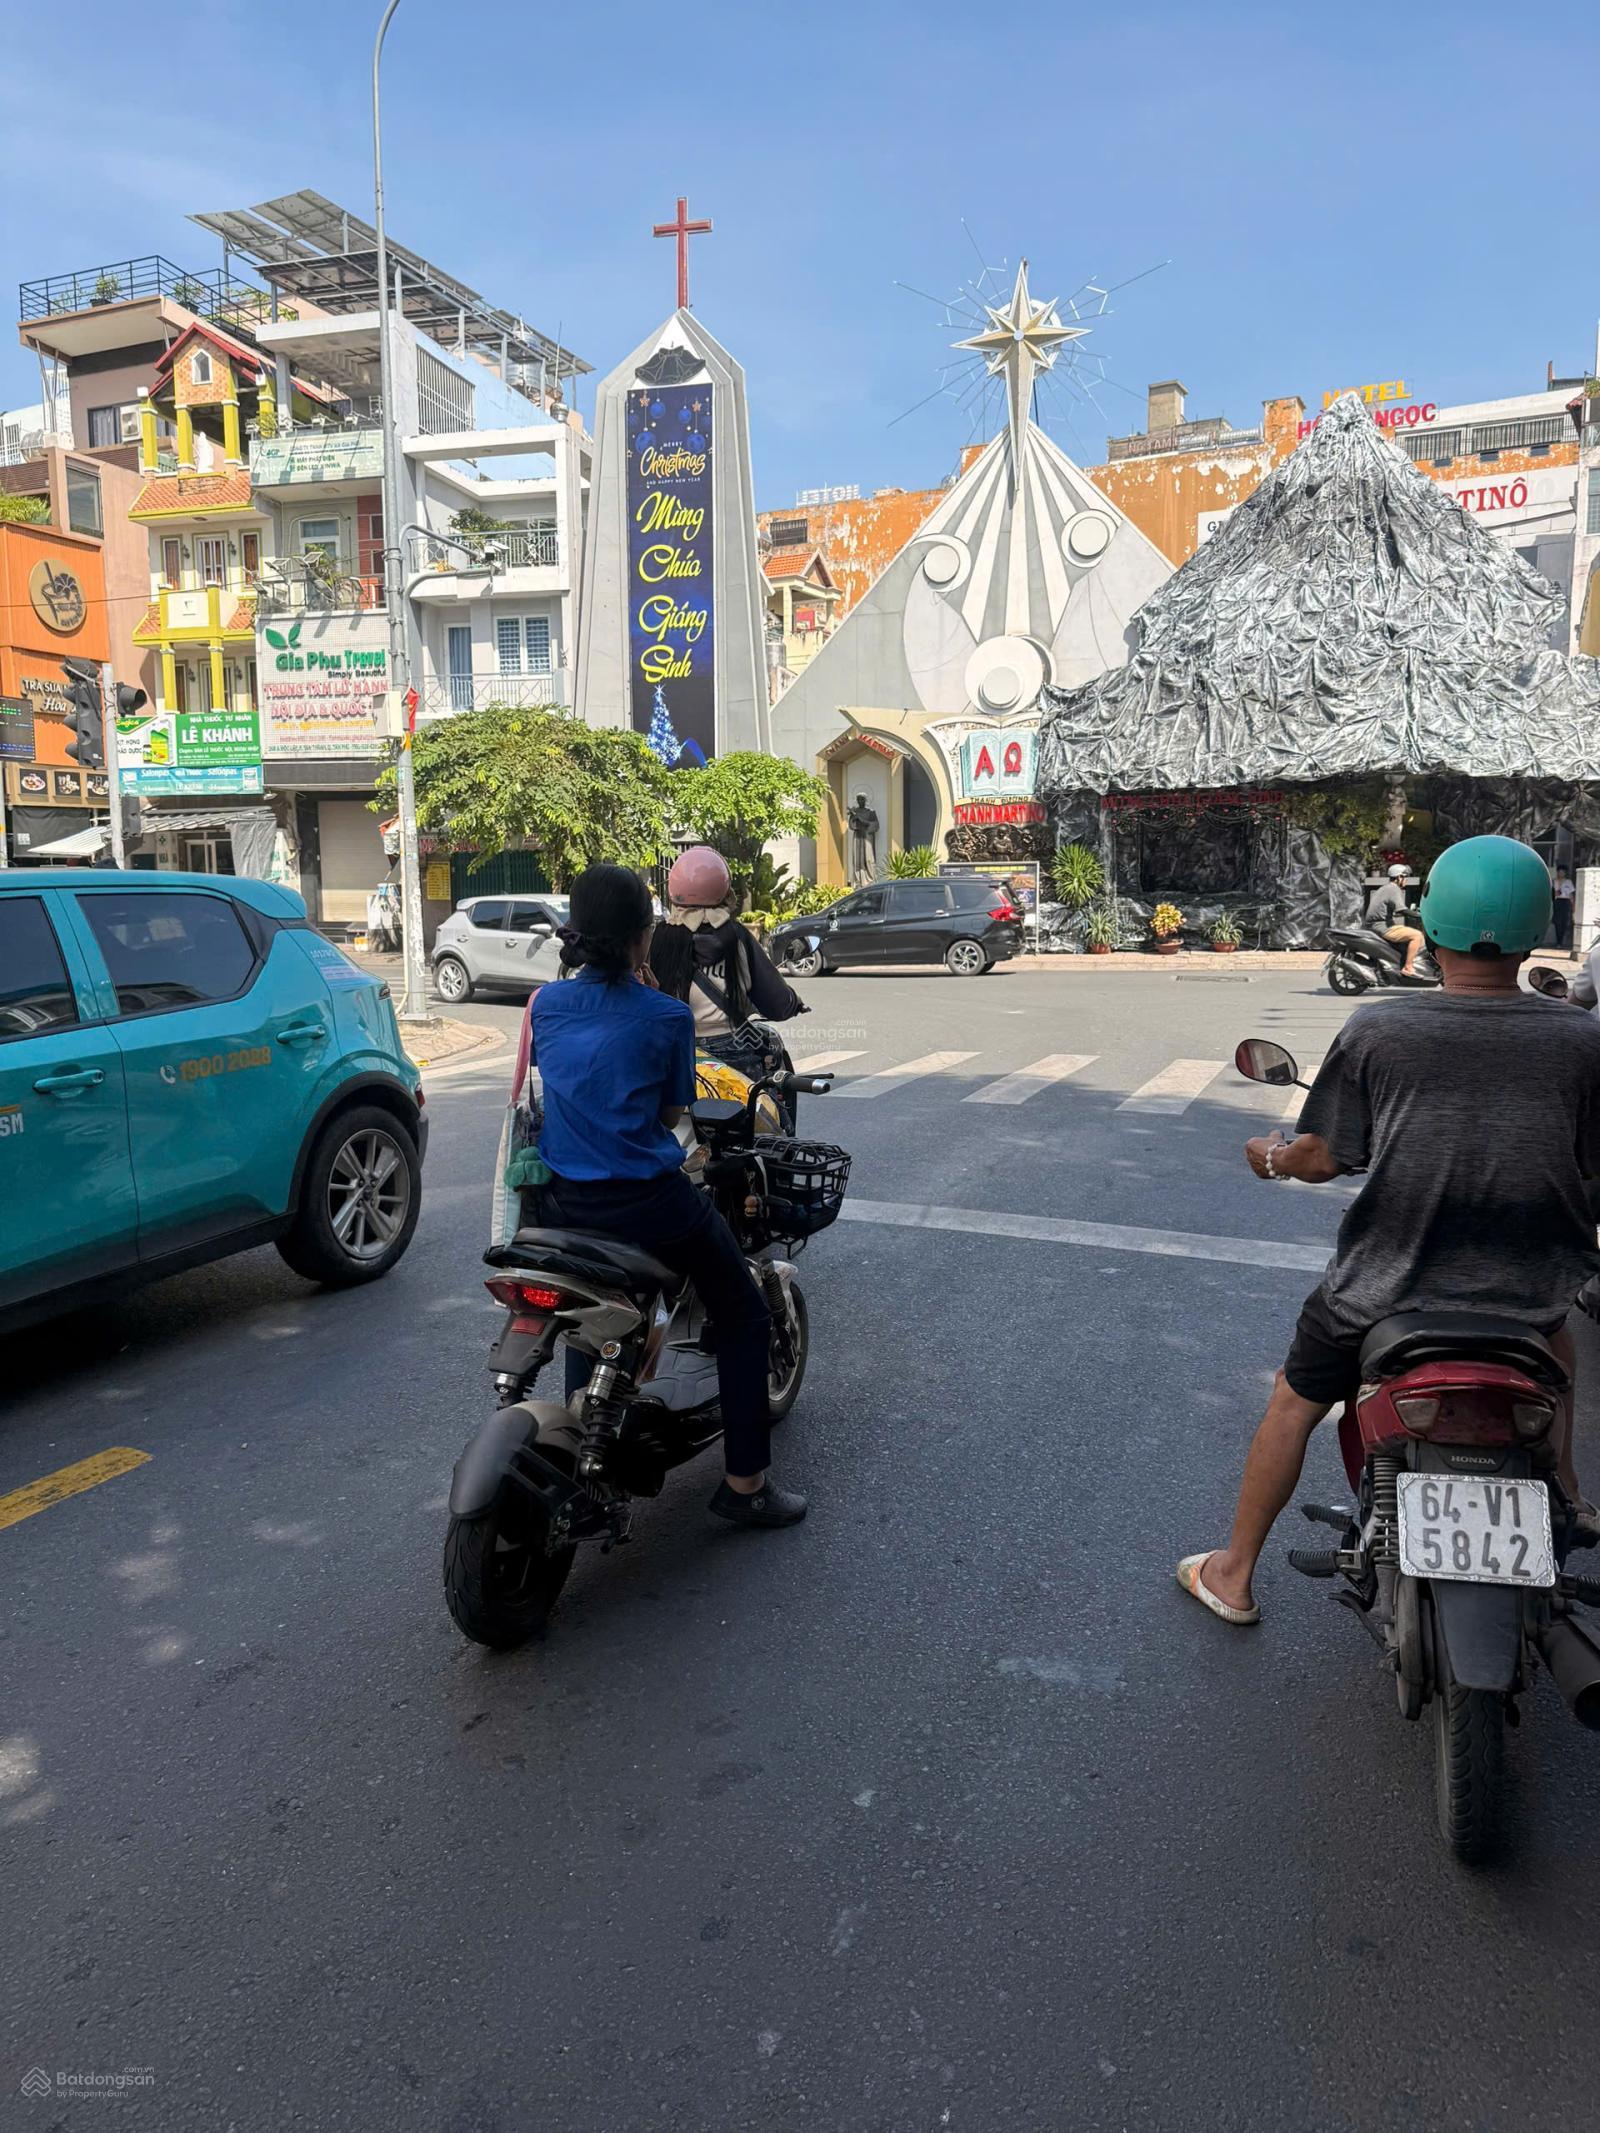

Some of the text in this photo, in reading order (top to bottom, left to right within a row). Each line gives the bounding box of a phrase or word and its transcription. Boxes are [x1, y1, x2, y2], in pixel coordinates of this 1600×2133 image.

[640, 446, 706, 478] Christmas
[658, 478, 674, 486] HAPPY
[687, 476, 701, 484] YEAR
[635, 490, 705, 542] Mừng
[638, 544, 702, 583] Chúa
[638, 594, 708, 643] Giáng
[276, 651, 305, 672] Gia
[328, 669, 386, 679] Simply Beautiful
[640, 644, 693, 684] Sinh
[42, 697, 67, 712] Hoa
[190, 715, 203, 723] NHÀ
[204, 713, 223, 722] THUỐC
[235, 713, 252, 721] NHÂN
[182, 725, 198, 744] LÊ
[202, 724, 254, 743] KHÁNH
[1003, 741, 1022, 775] Ω
[180, 1046, 272, 1081] 1900 2088
[1450, 1455, 1496, 1465] HONDA
[1421, 1482, 1521, 1528] 64-V1
[1422, 1528, 1531, 1577] 5842
